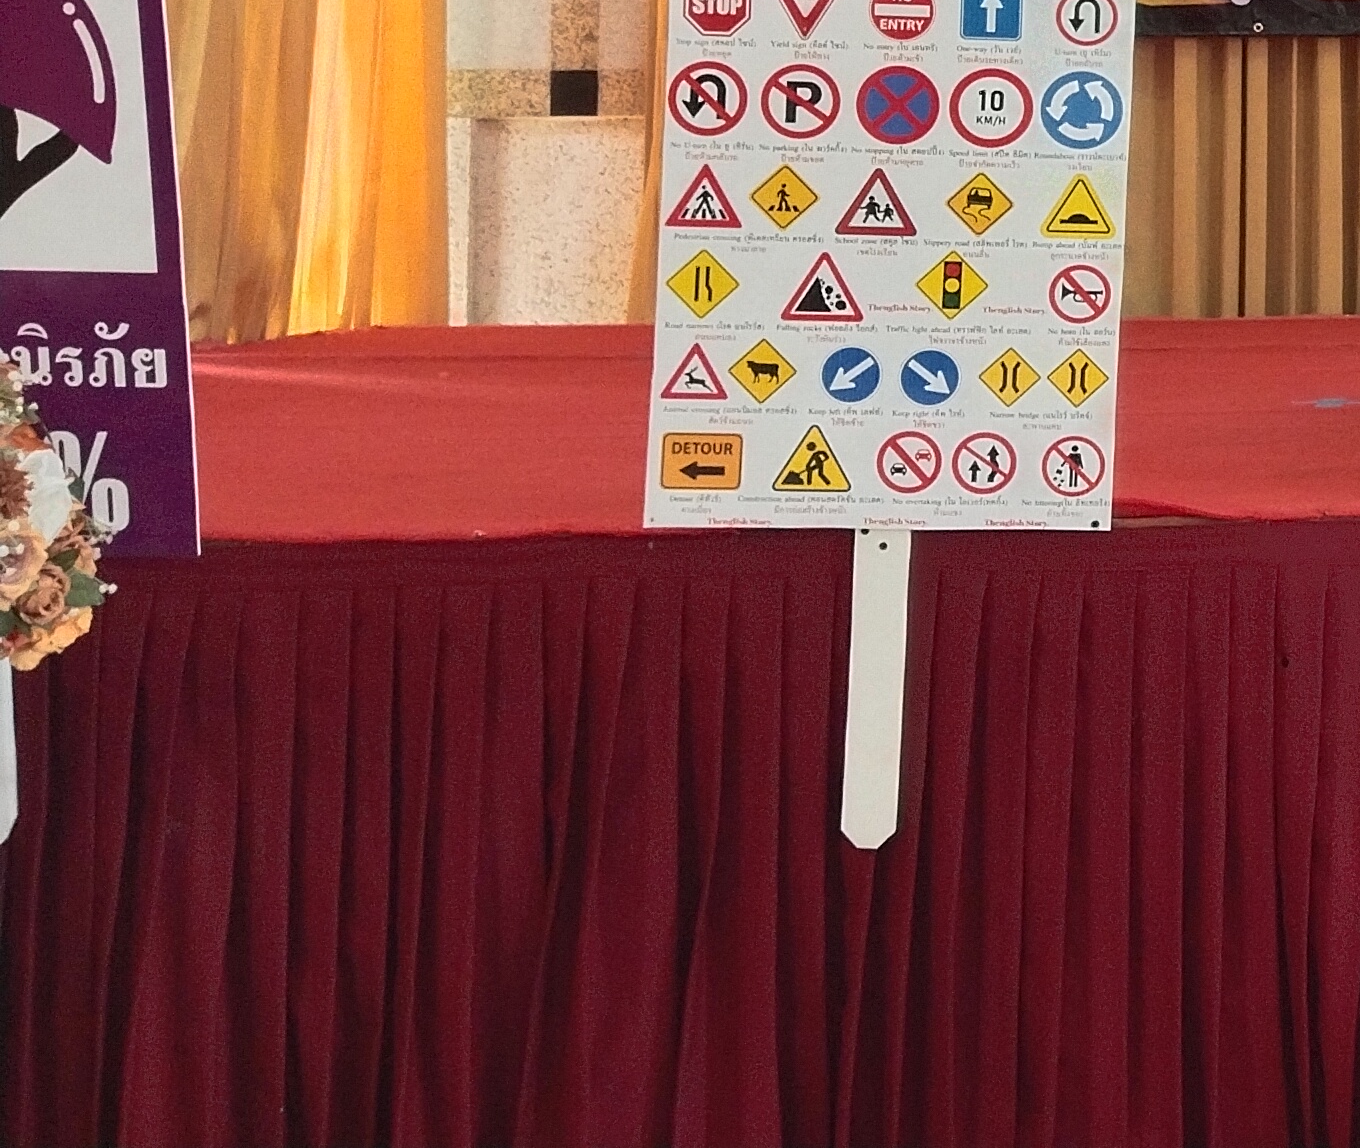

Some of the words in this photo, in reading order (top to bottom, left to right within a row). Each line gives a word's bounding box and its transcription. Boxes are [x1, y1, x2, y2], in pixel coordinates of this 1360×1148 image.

[879, 18, 925, 31] ENTRY
[978, 89, 1005, 112] 10
[976, 115, 1006, 126] KM/H
[671, 441, 733, 456] DETOUR
